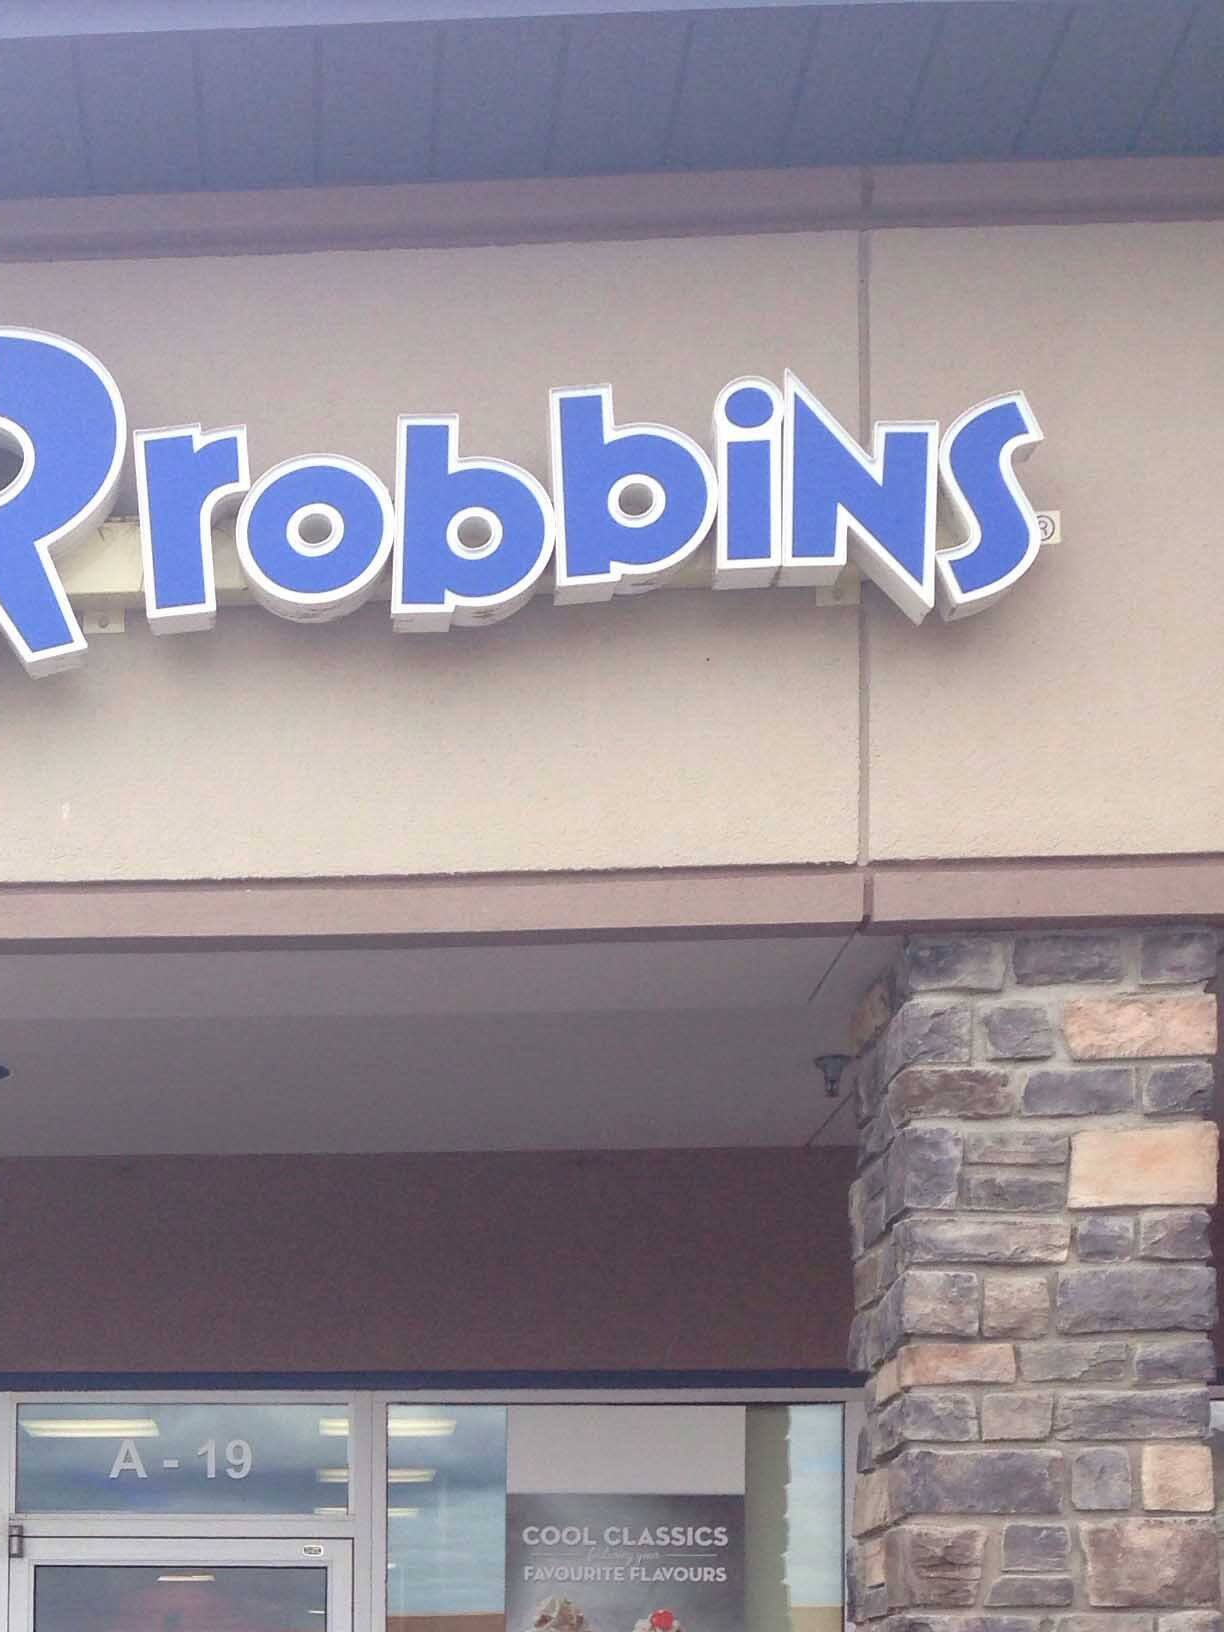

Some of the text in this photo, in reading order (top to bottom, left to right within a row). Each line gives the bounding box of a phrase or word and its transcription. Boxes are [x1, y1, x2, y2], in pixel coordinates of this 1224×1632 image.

[109, 1439, 148, 1478] A
[197, 1439, 252, 1479] 19
[522, 1526, 728, 1546] COOL CLASSICS
[524, 1566, 727, 1582] FAVOURITE FLAVOURS
